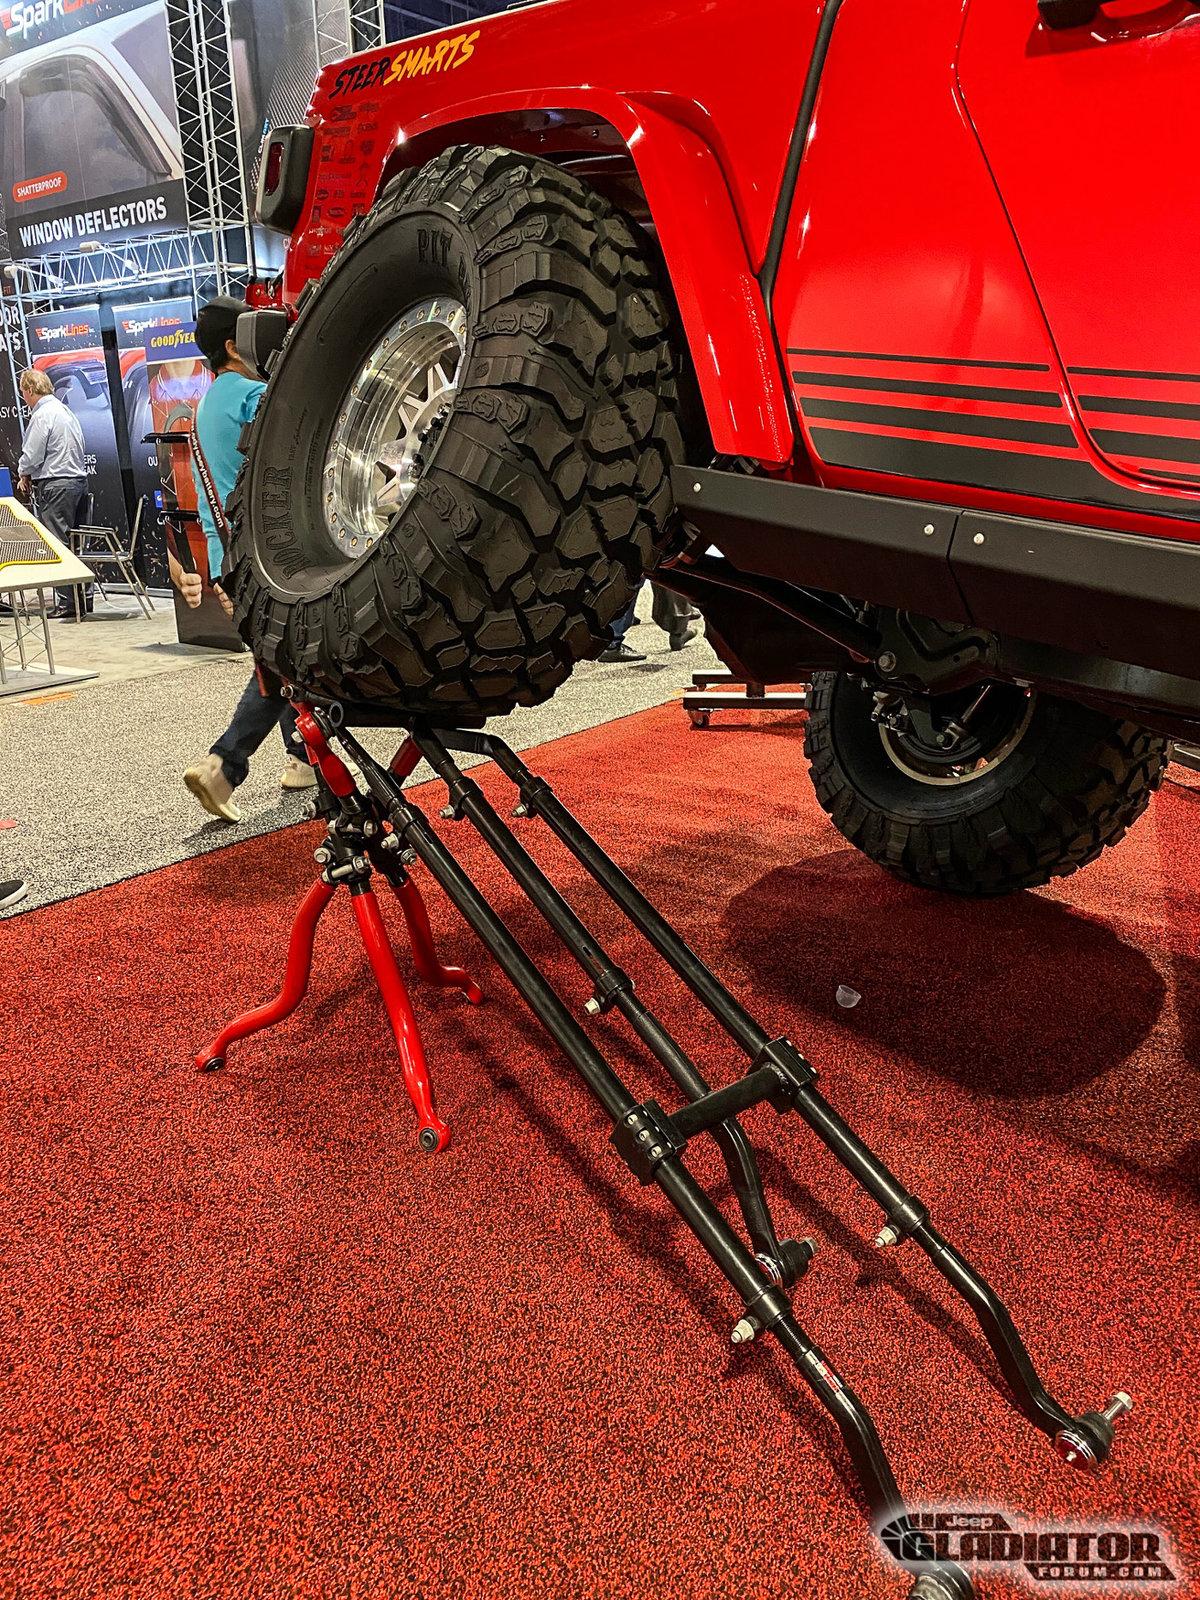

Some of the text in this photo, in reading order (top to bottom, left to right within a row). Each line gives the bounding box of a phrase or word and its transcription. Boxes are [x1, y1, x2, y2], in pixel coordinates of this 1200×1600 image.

[16, 176, 62, 198] SHATTERPROOF
[19, 196, 168, 248] WINDOW DEFLECTORS
[416, 228, 454, 267] PIT
[150, 330, 196, 348] GOODYEA
